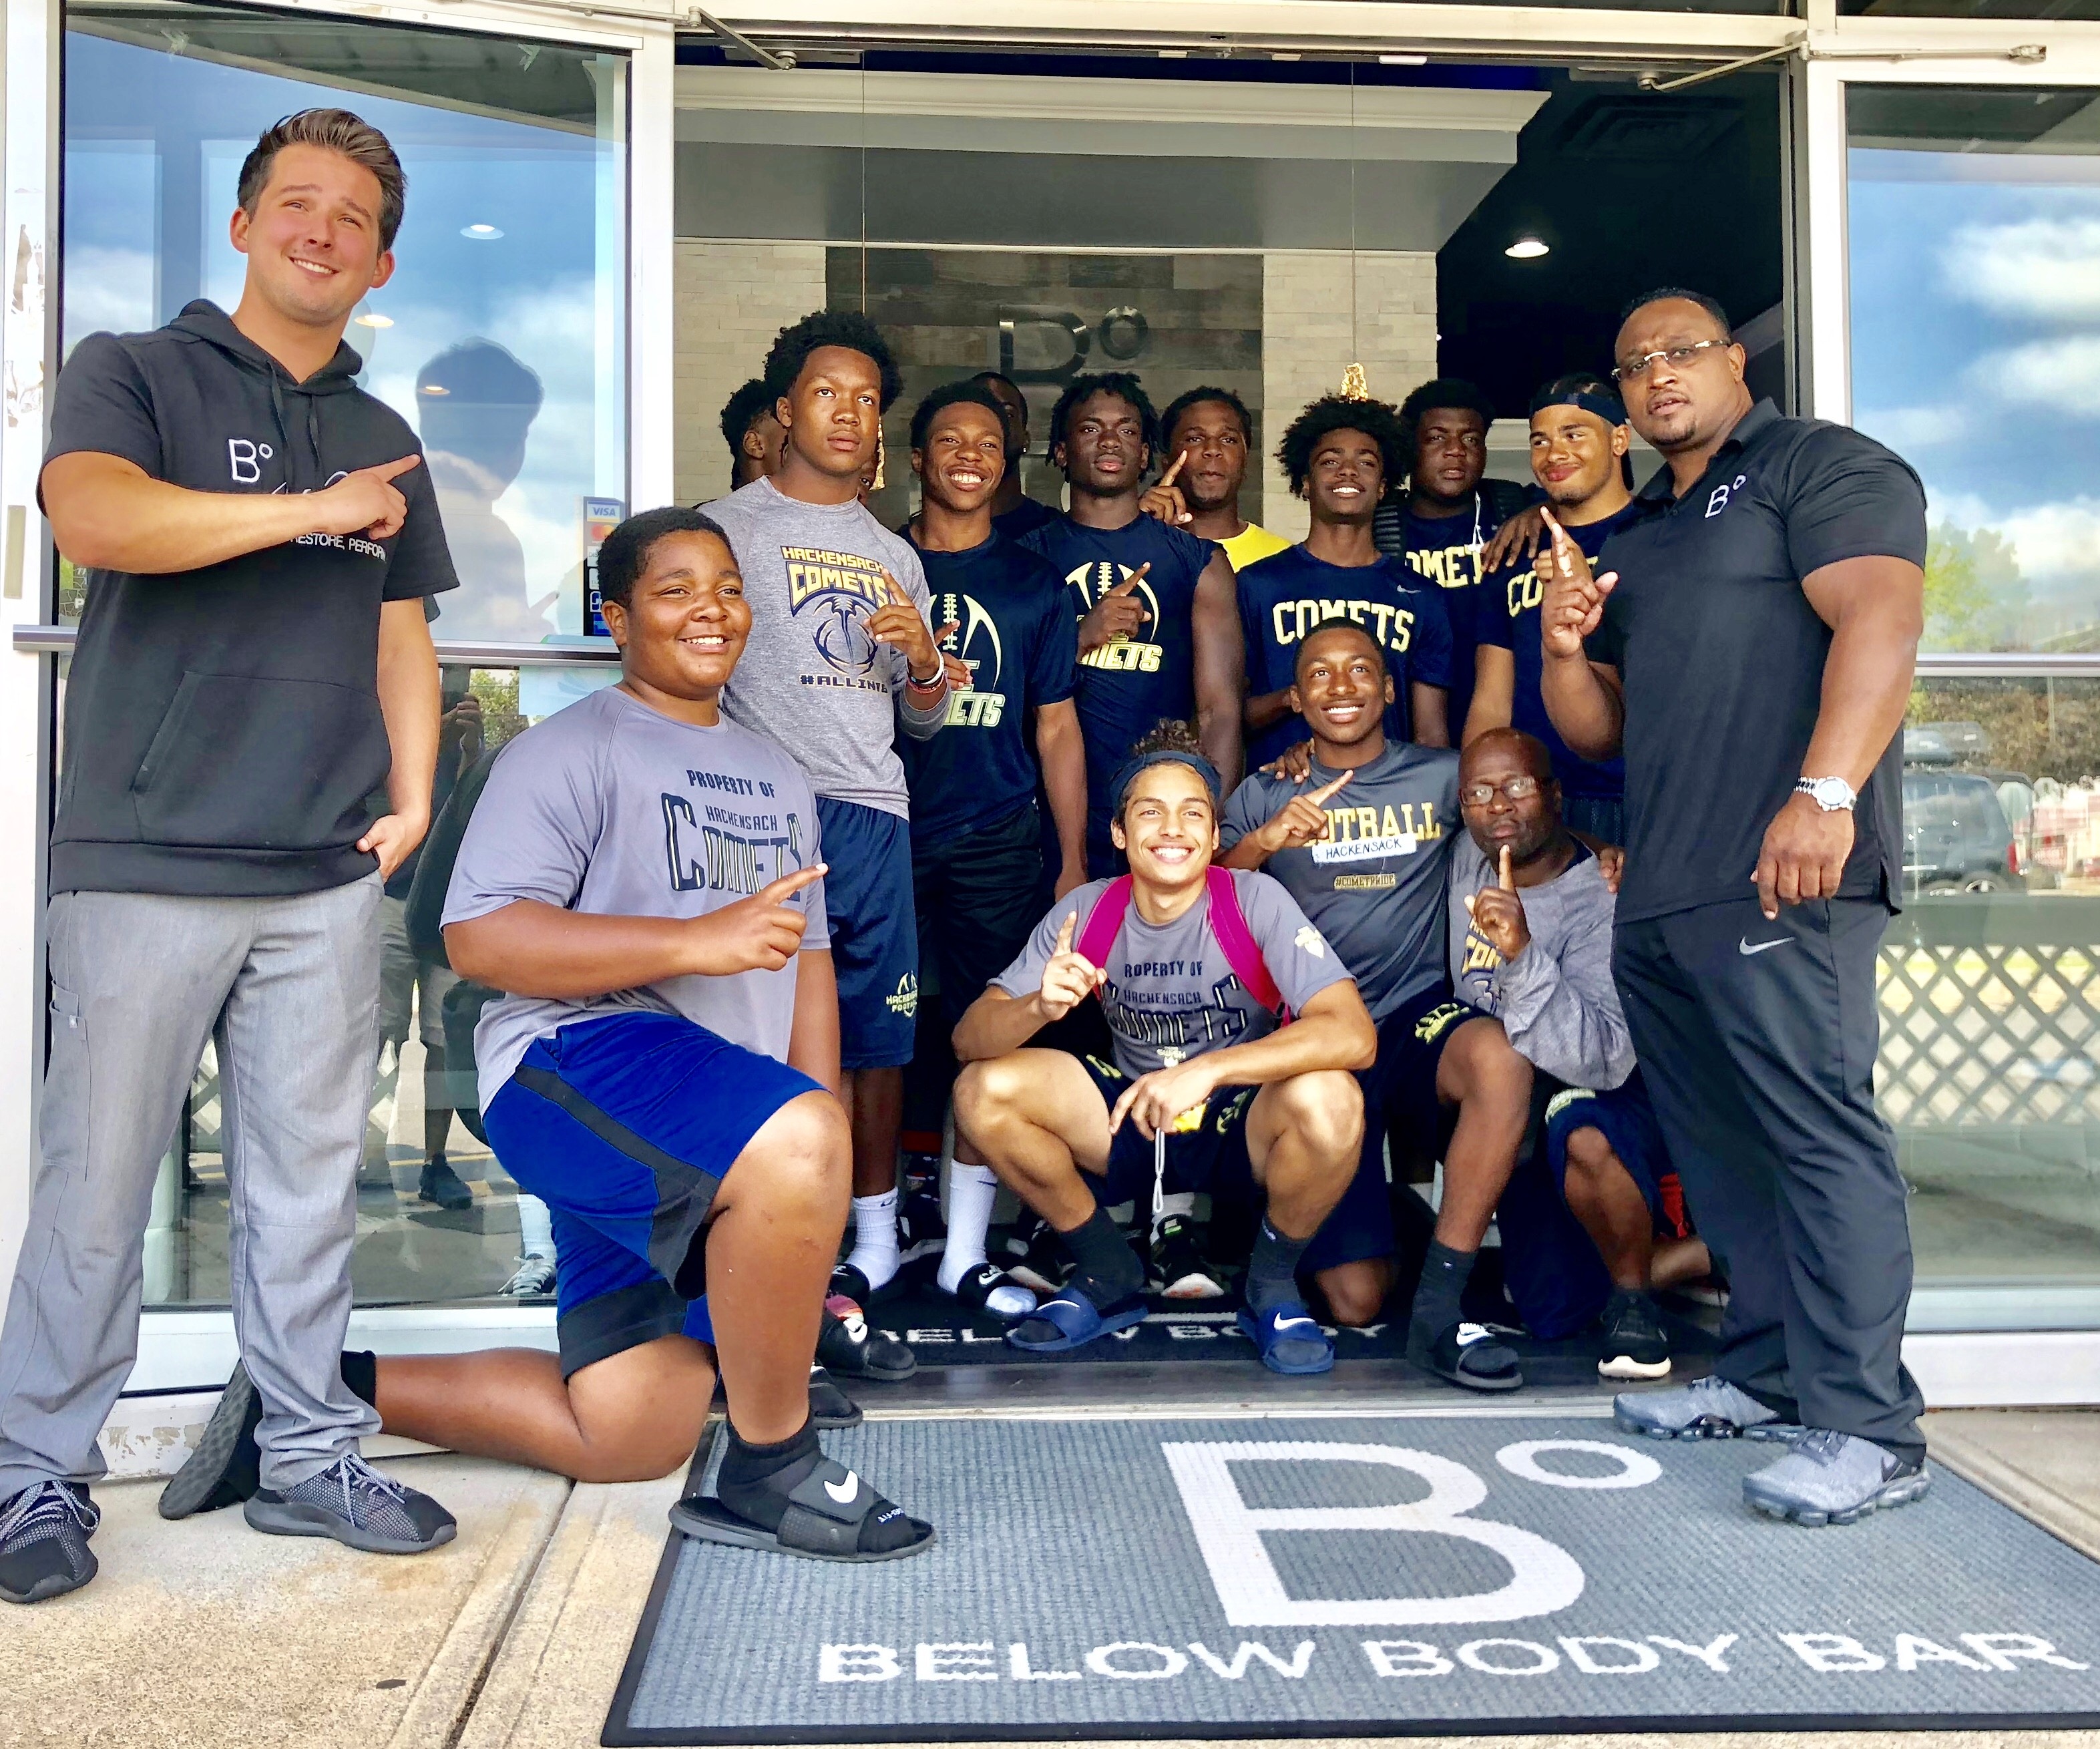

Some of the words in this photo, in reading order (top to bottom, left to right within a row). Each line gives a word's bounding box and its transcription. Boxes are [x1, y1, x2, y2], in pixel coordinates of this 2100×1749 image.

[592, 506, 616, 517] VISA
[781, 546, 884, 574] HACKENSACK
[787, 562, 891, 611] COMETS
[686, 769, 754, 796] PROPERTY
[759, 781, 775, 799] OF
[704, 804, 779, 831] HACKENSACK
[1325, 837, 1402, 860] HACKENSACK
[1335, 873, 1396, 888] #COMETPRIDE
[1124, 960, 1185, 978] ROPERTY
[1189, 960, 1203, 976] OF
[817, 1640, 1316, 1683] BELOW
[1365, 1633, 1739, 1678] BODY
[1776, 1631, 2091, 1673] BAR
